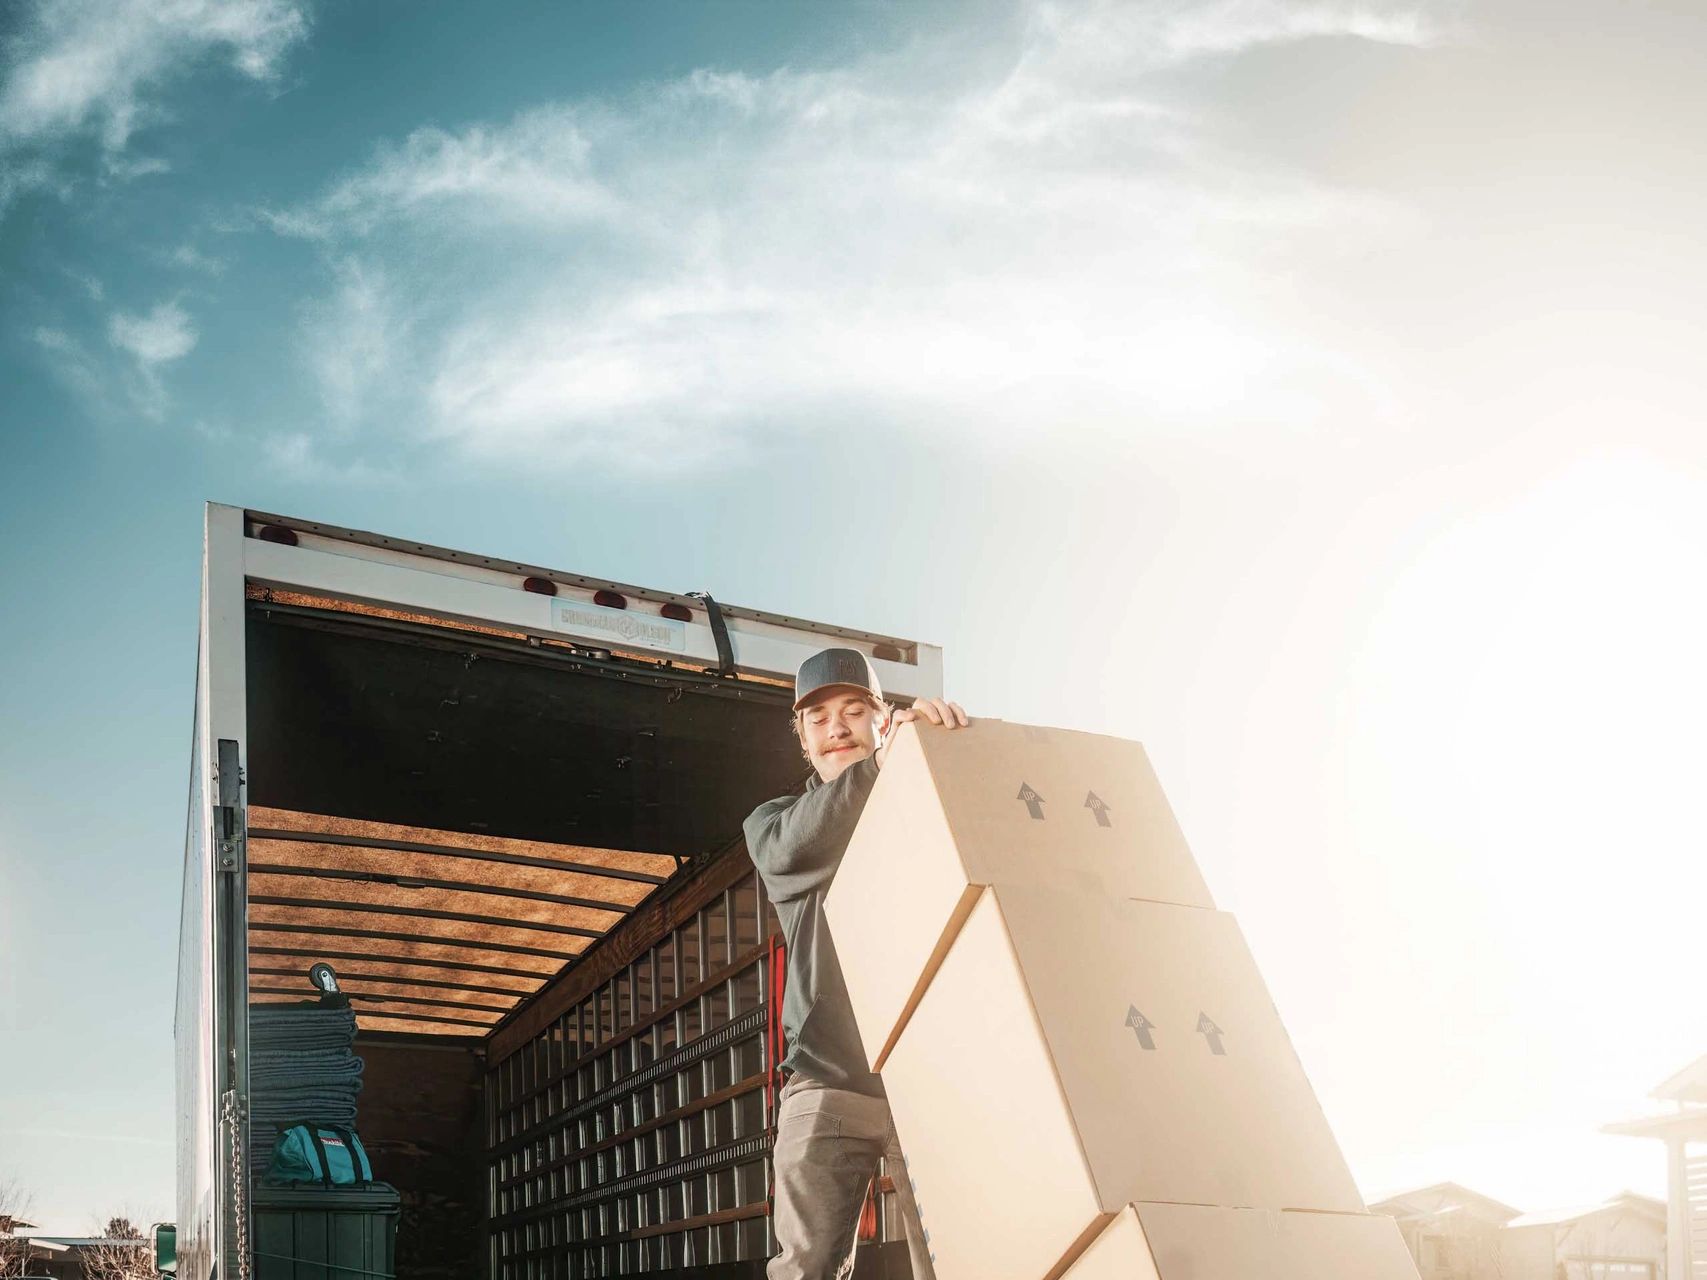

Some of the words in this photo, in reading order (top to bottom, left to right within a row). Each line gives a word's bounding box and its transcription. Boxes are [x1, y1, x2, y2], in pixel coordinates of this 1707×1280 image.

[1022, 791, 1035, 800] UP
[1089, 799, 1101, 808] UP
[1131, 1015, 1143, 1027] UP
[1201, 1021, 1214, 1033] UP
